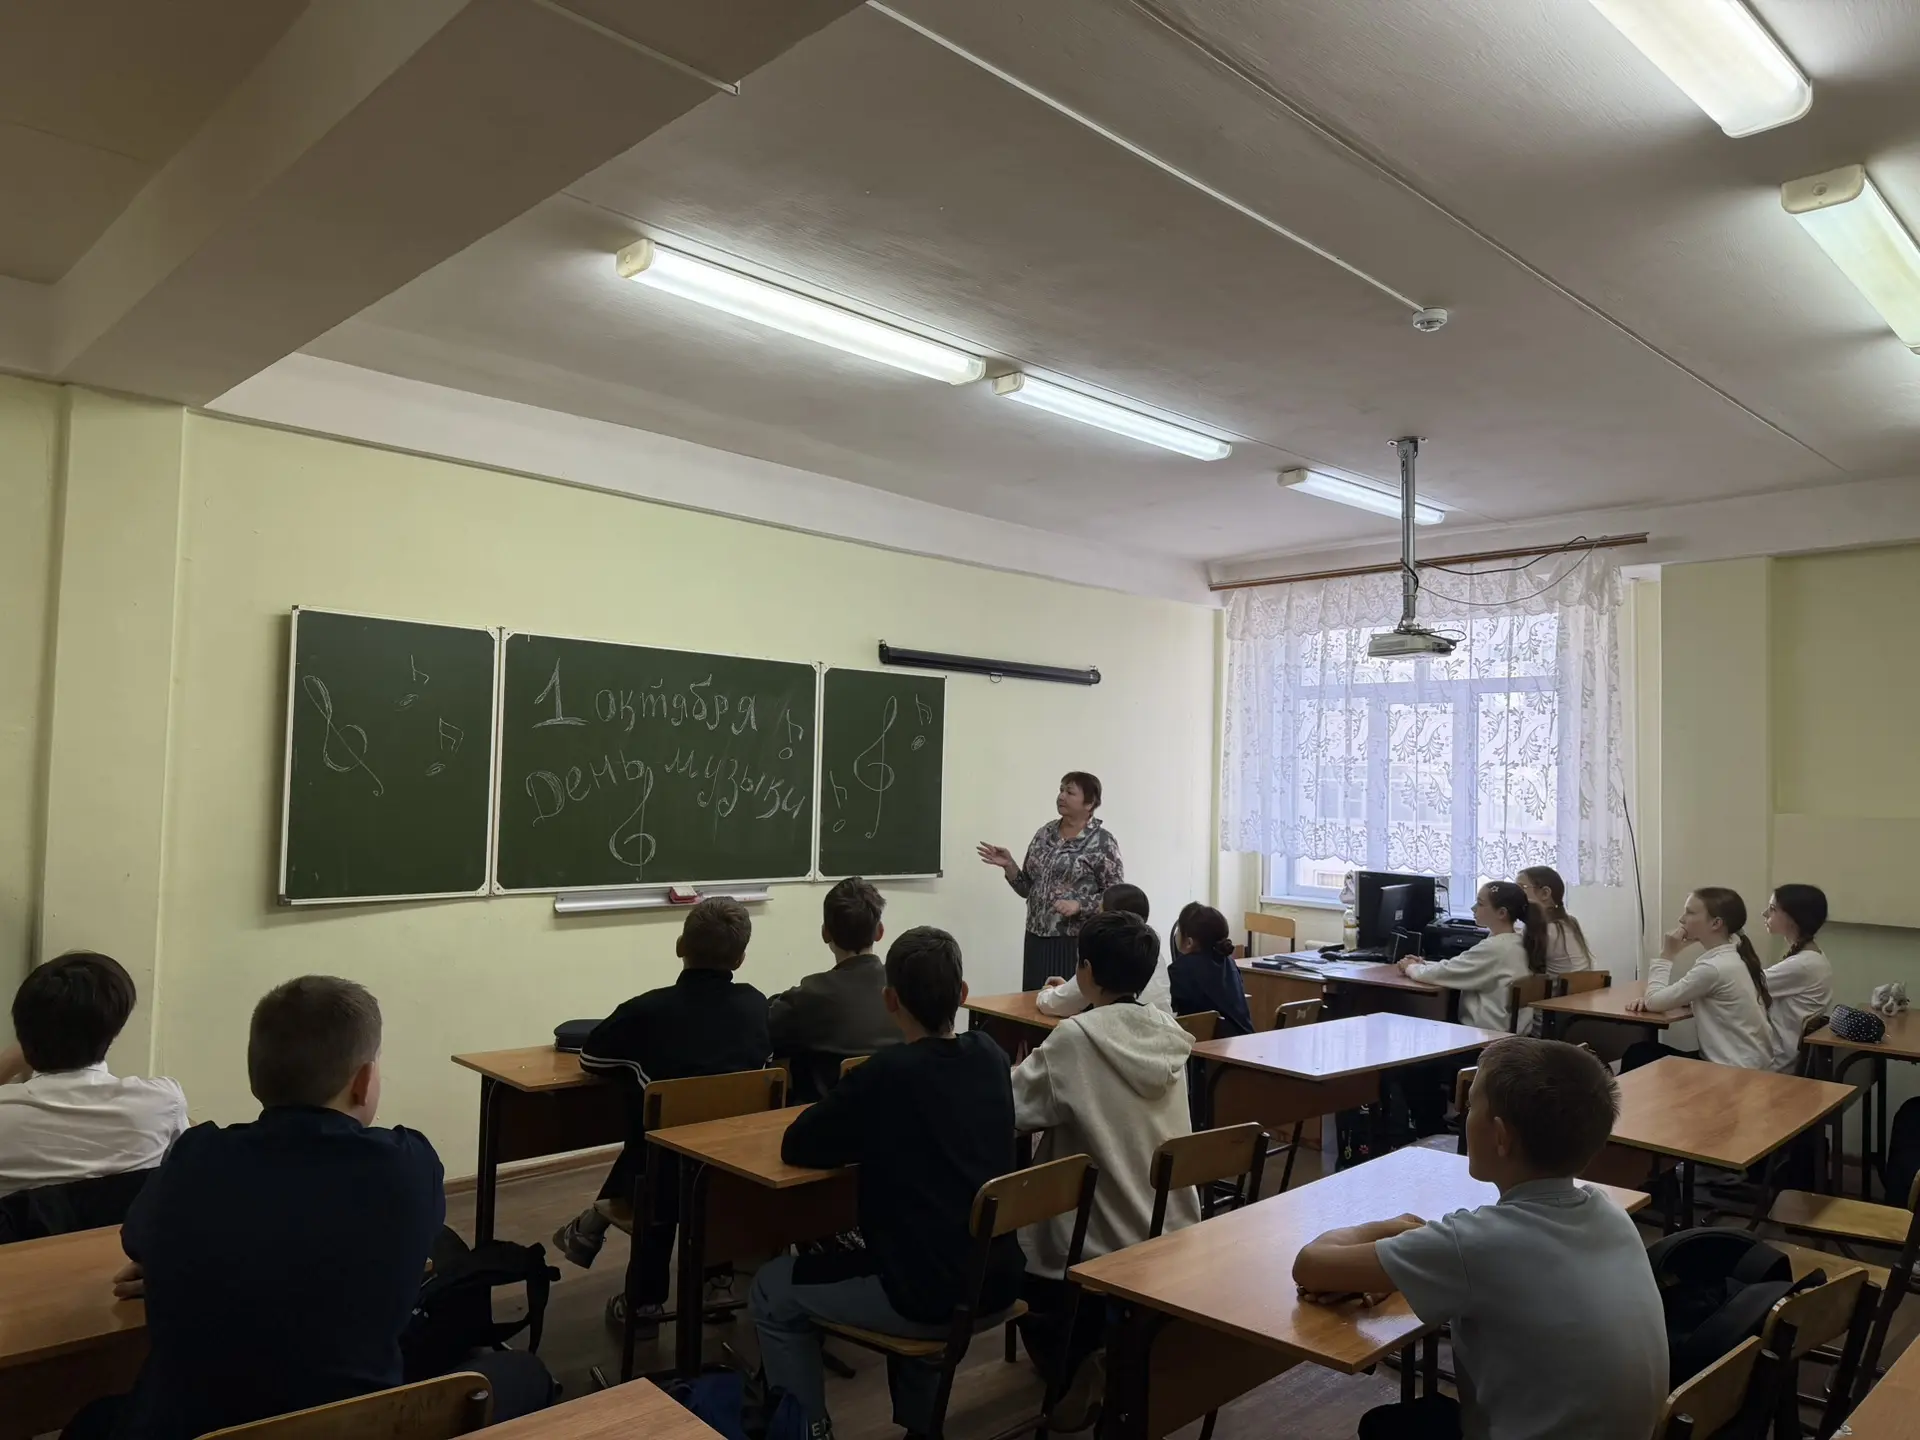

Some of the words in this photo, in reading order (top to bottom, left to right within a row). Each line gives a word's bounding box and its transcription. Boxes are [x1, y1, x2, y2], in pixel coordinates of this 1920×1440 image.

[532, 657, 589, 728] 1
[525, 749, 645, 827] День
[665, 748, 805, 818] музыки
